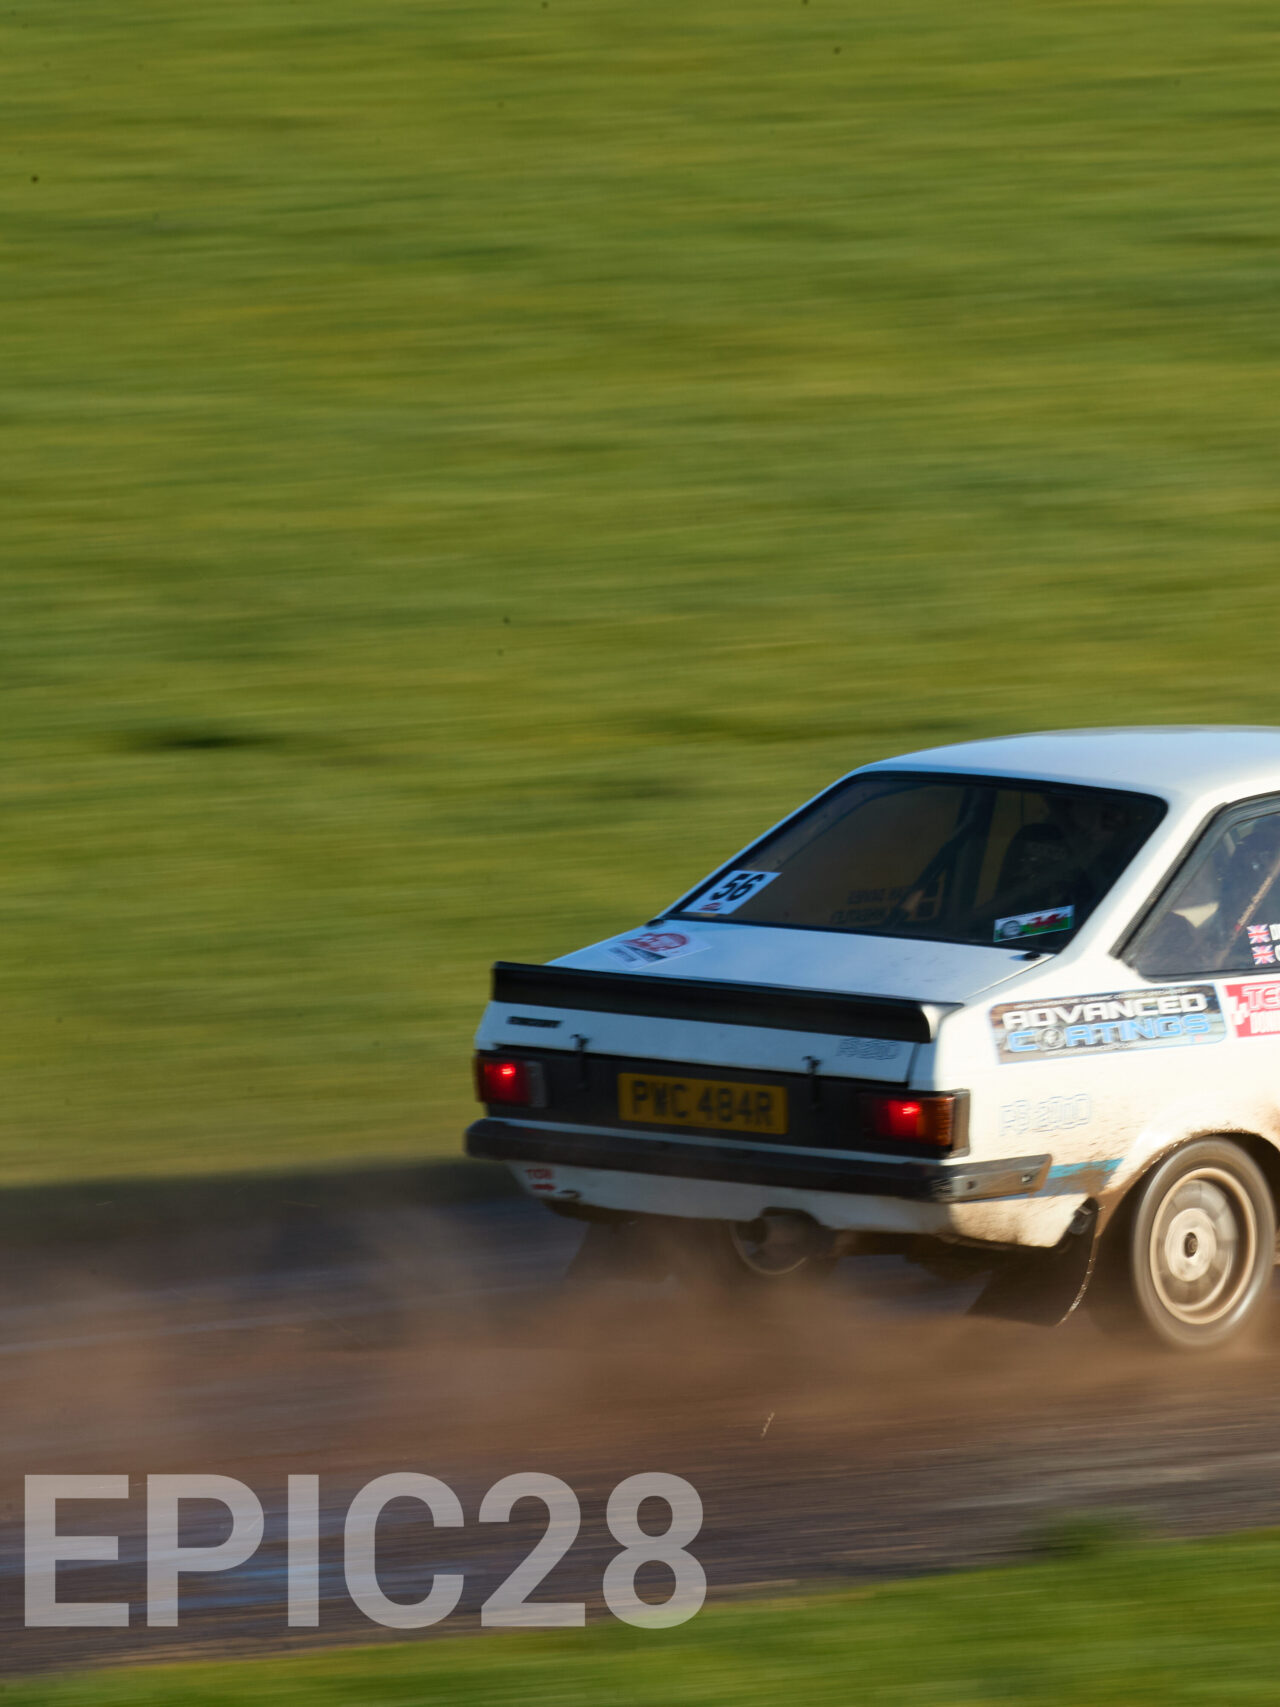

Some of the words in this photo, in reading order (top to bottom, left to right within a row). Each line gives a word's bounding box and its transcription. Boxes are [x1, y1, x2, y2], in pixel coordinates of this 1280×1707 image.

[709, 873, 766, 901] 56
[1002, 993, 1208, 1030] ADVANCED
[1007, 1013, 1211, 1053] COATINGS
[632, 1081, 688, 1118] PWC
[697, 1087, 773, 1127] 484R
